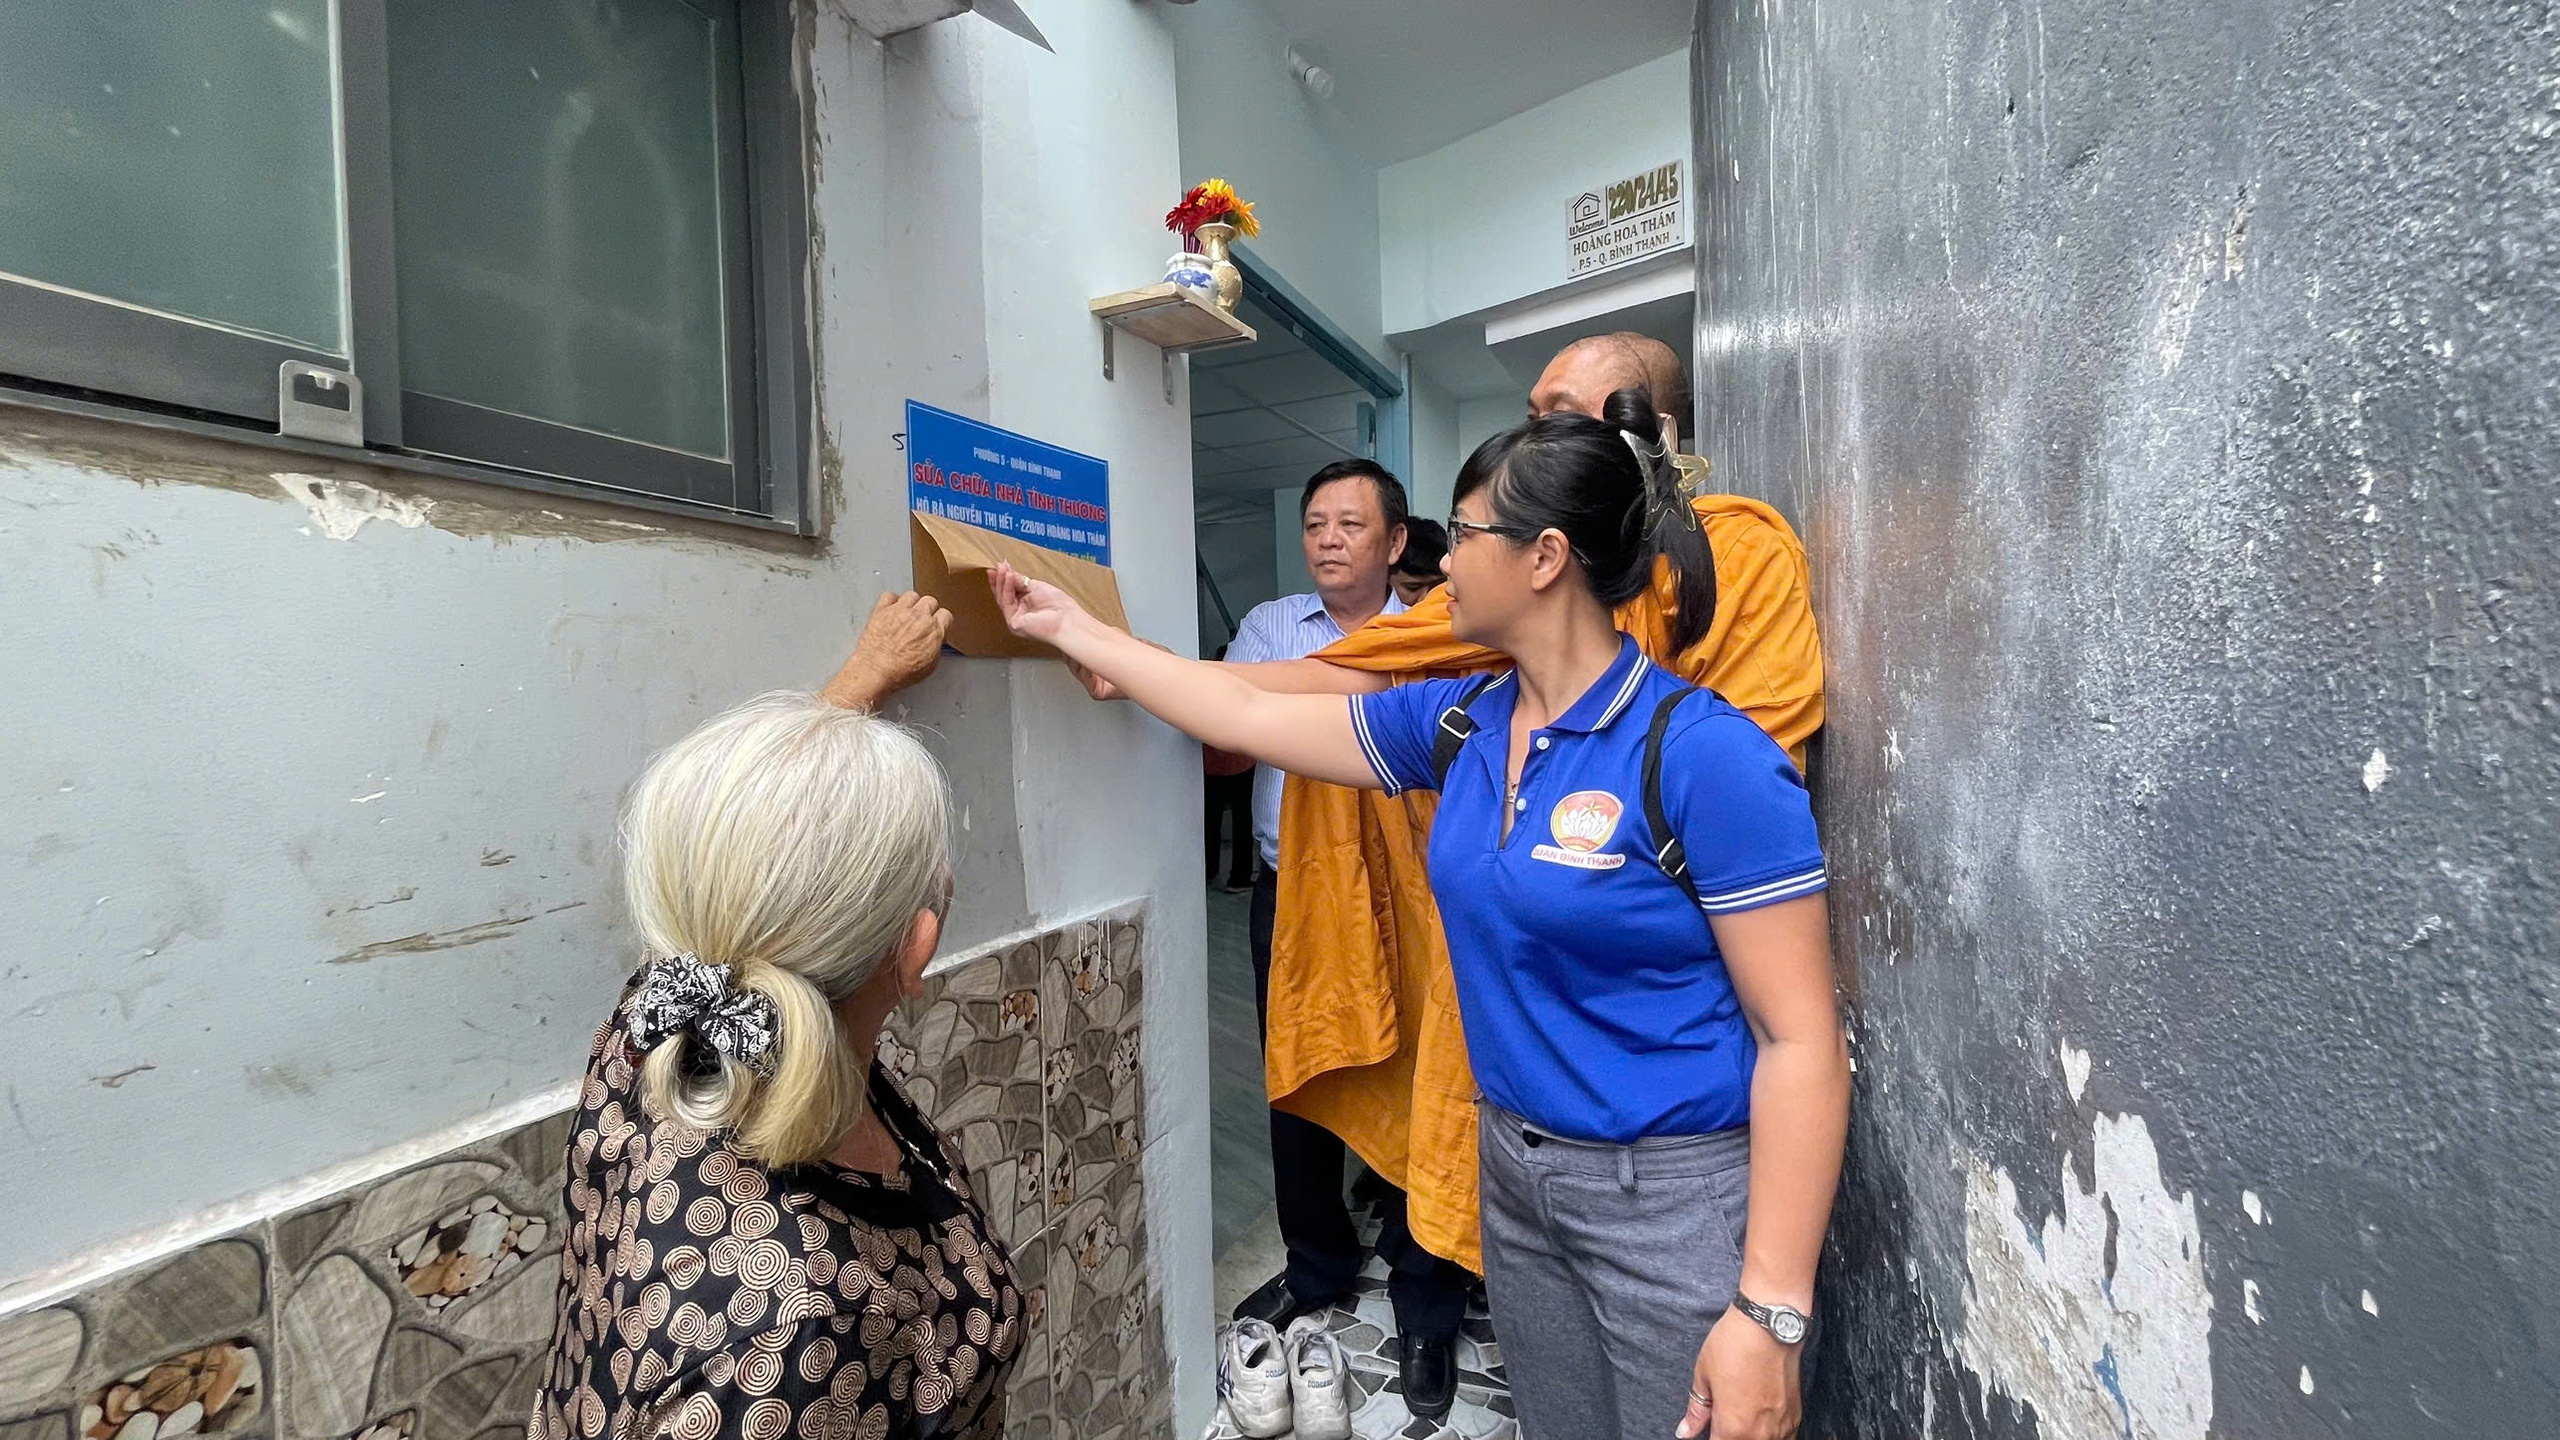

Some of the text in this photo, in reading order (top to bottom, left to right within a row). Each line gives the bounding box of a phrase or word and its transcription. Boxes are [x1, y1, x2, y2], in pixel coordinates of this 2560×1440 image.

[1570, 219, 1605, 236] Welcome
[1573, 211, 1676, 256] HOÀNG HOA THÁM
[1579, 256, 1591, 270] P.5
[1599, 252, 1608, 265] Q.
[1610, 243, 1634, 260] BÌNH
[1635, 231, 1670, 251] THẠNH
[914, 458, 1107, 523] SỬA CHỮA NHÀ TÌNH THƯƠNG
[931, 499, 945, 518] BÀ
[946, 503, 982, 524] NGUYỄN
[984, 511, 998, 530] THỊ
[999, 511, 1013, 530] HẾT
[1046, 523, 1071, 541] HOÀNG
[1071, 529, 1086, 544] HOA
[1087, 530, 1106, 547] THÁM
[1560, 852, 1584, 865] BÌNH
